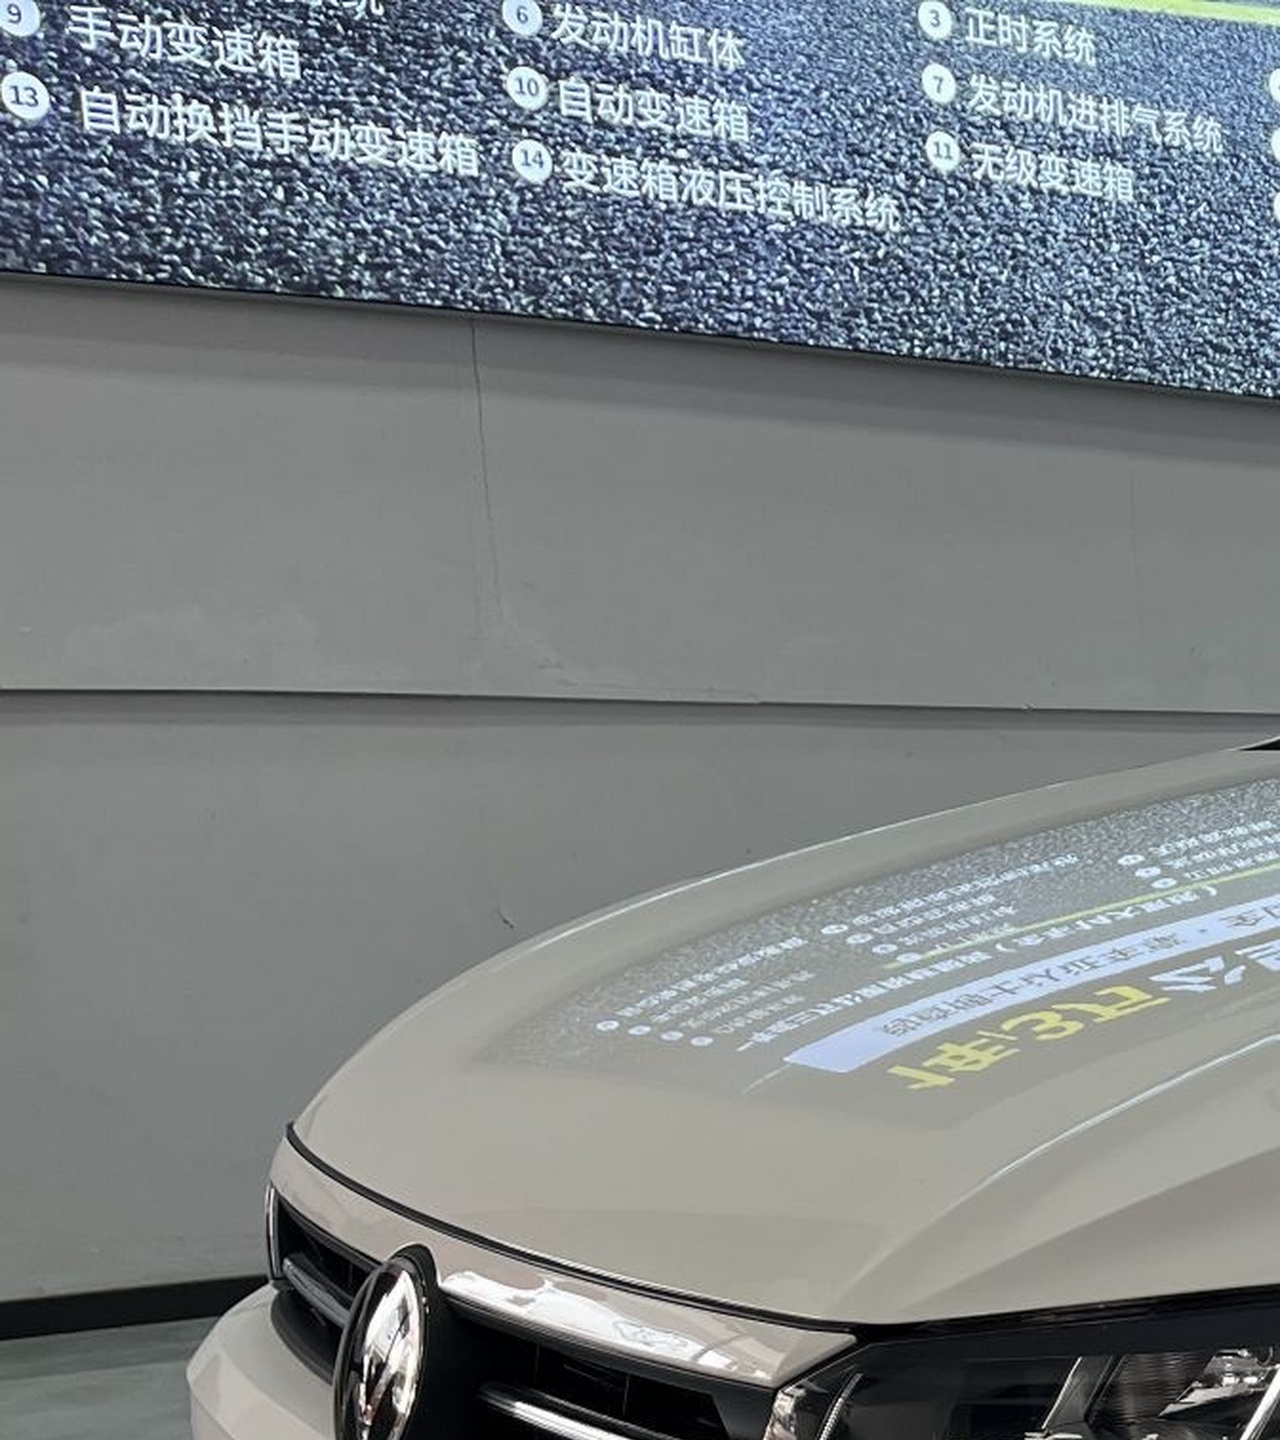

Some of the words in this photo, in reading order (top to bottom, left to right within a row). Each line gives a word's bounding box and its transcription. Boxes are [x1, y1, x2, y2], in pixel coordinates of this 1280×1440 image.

[7, 3, 22, 24] 9
[68, 6, 301, 81] 手动变速箱
[552, 5, 745, 71] 发动机缸体
[965, 10, 1096, 67] 正时系统
[9, 85, 38, 108] 13
[80, 86, 480, 177] 自动换挡手动变速箱
[518, 77, 539, 96] 10
[558, 76, 749, 141] 自动变速箱
[967, 76, 1224, 153] 发动机进排气系统
[520, 149, 544, 168] 14
[562, 150, 901, 230] 变速箱液压控制系统
[971, 142, 1134, 202] 无级变速箱
